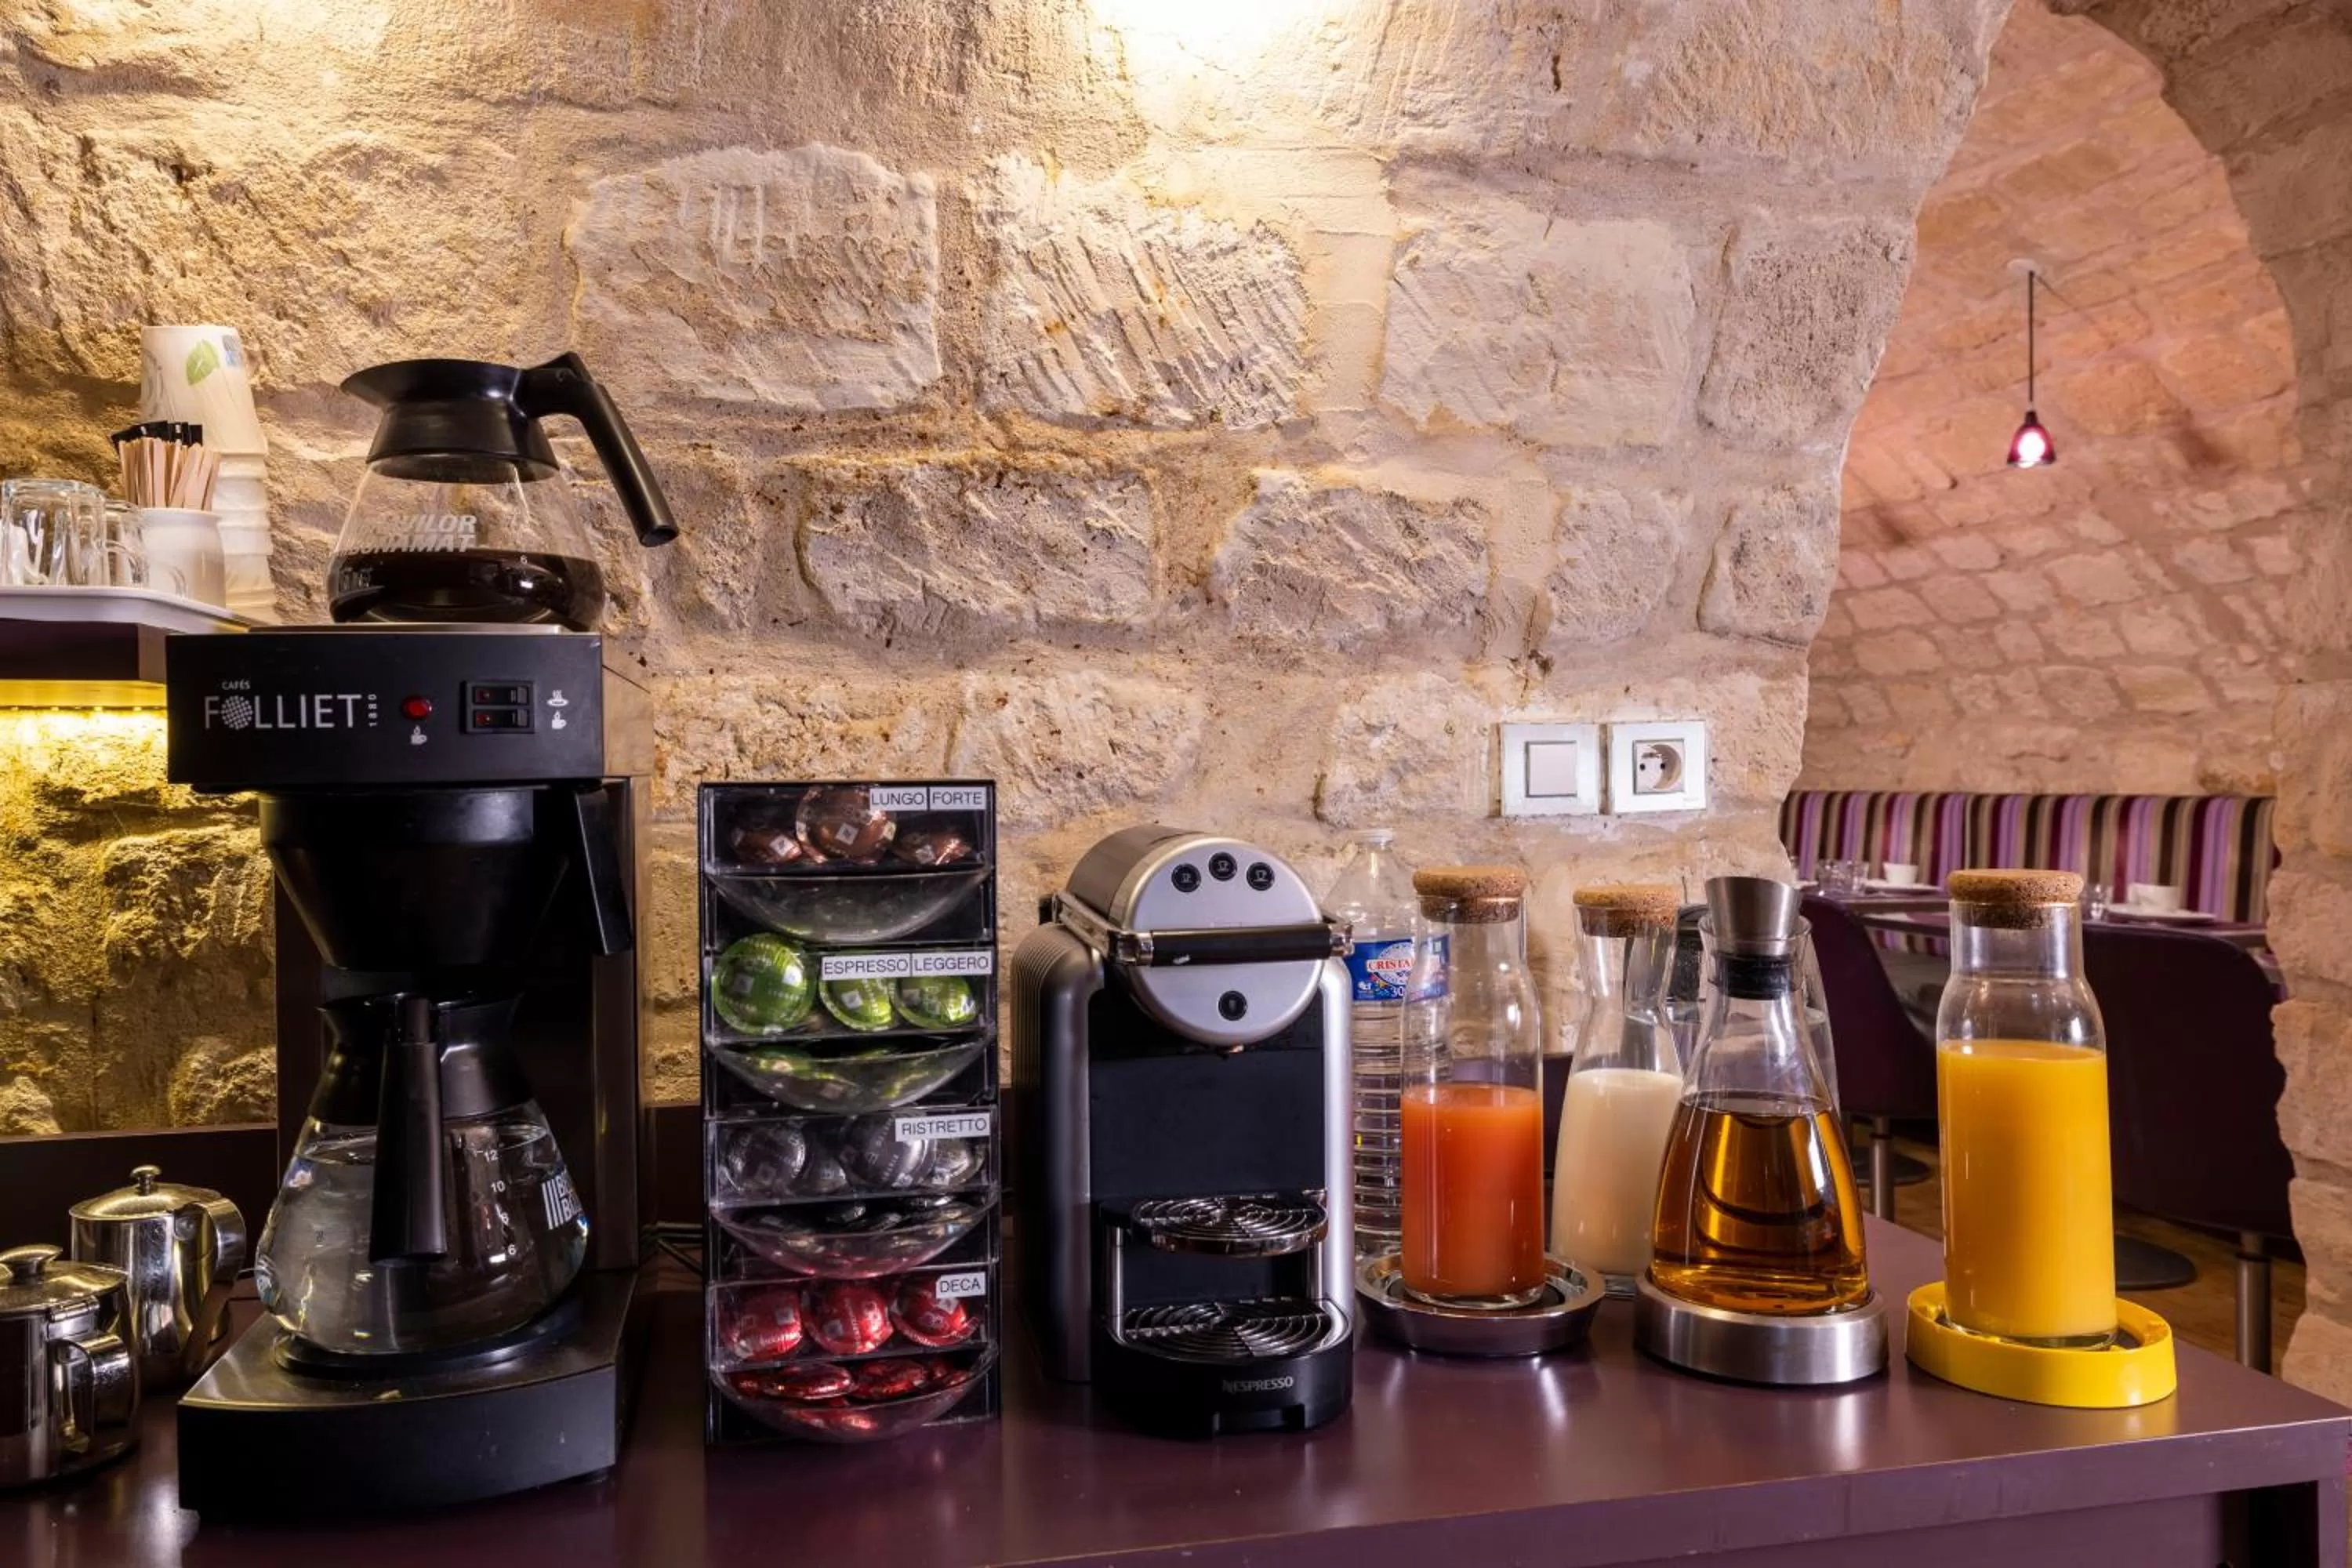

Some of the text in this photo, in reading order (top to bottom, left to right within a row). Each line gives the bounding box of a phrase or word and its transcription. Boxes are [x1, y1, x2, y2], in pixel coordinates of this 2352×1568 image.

[221, 679, 251, 691] CAFÉS
[204, 694, 362, 730] FOLLIET
[368, 694, 378, 728] 1880
[871, 791, 983, 805] LUNGO FORTE
[823, 956, 989, 975] ESPRESSO LEGGERO
[1368, 959, 1412, 971] CRISTA
[902, 1118, 987, 1135] RISTRETTO
[484, 1149, 499, 1163] 12
[491, 1180, 506, 1192] 10
[507, 1244, 517, 1255] 6
[939, 1277, 982, 1293] DECA
[1222, 1376, 1294, 1394] NESPRESSO
